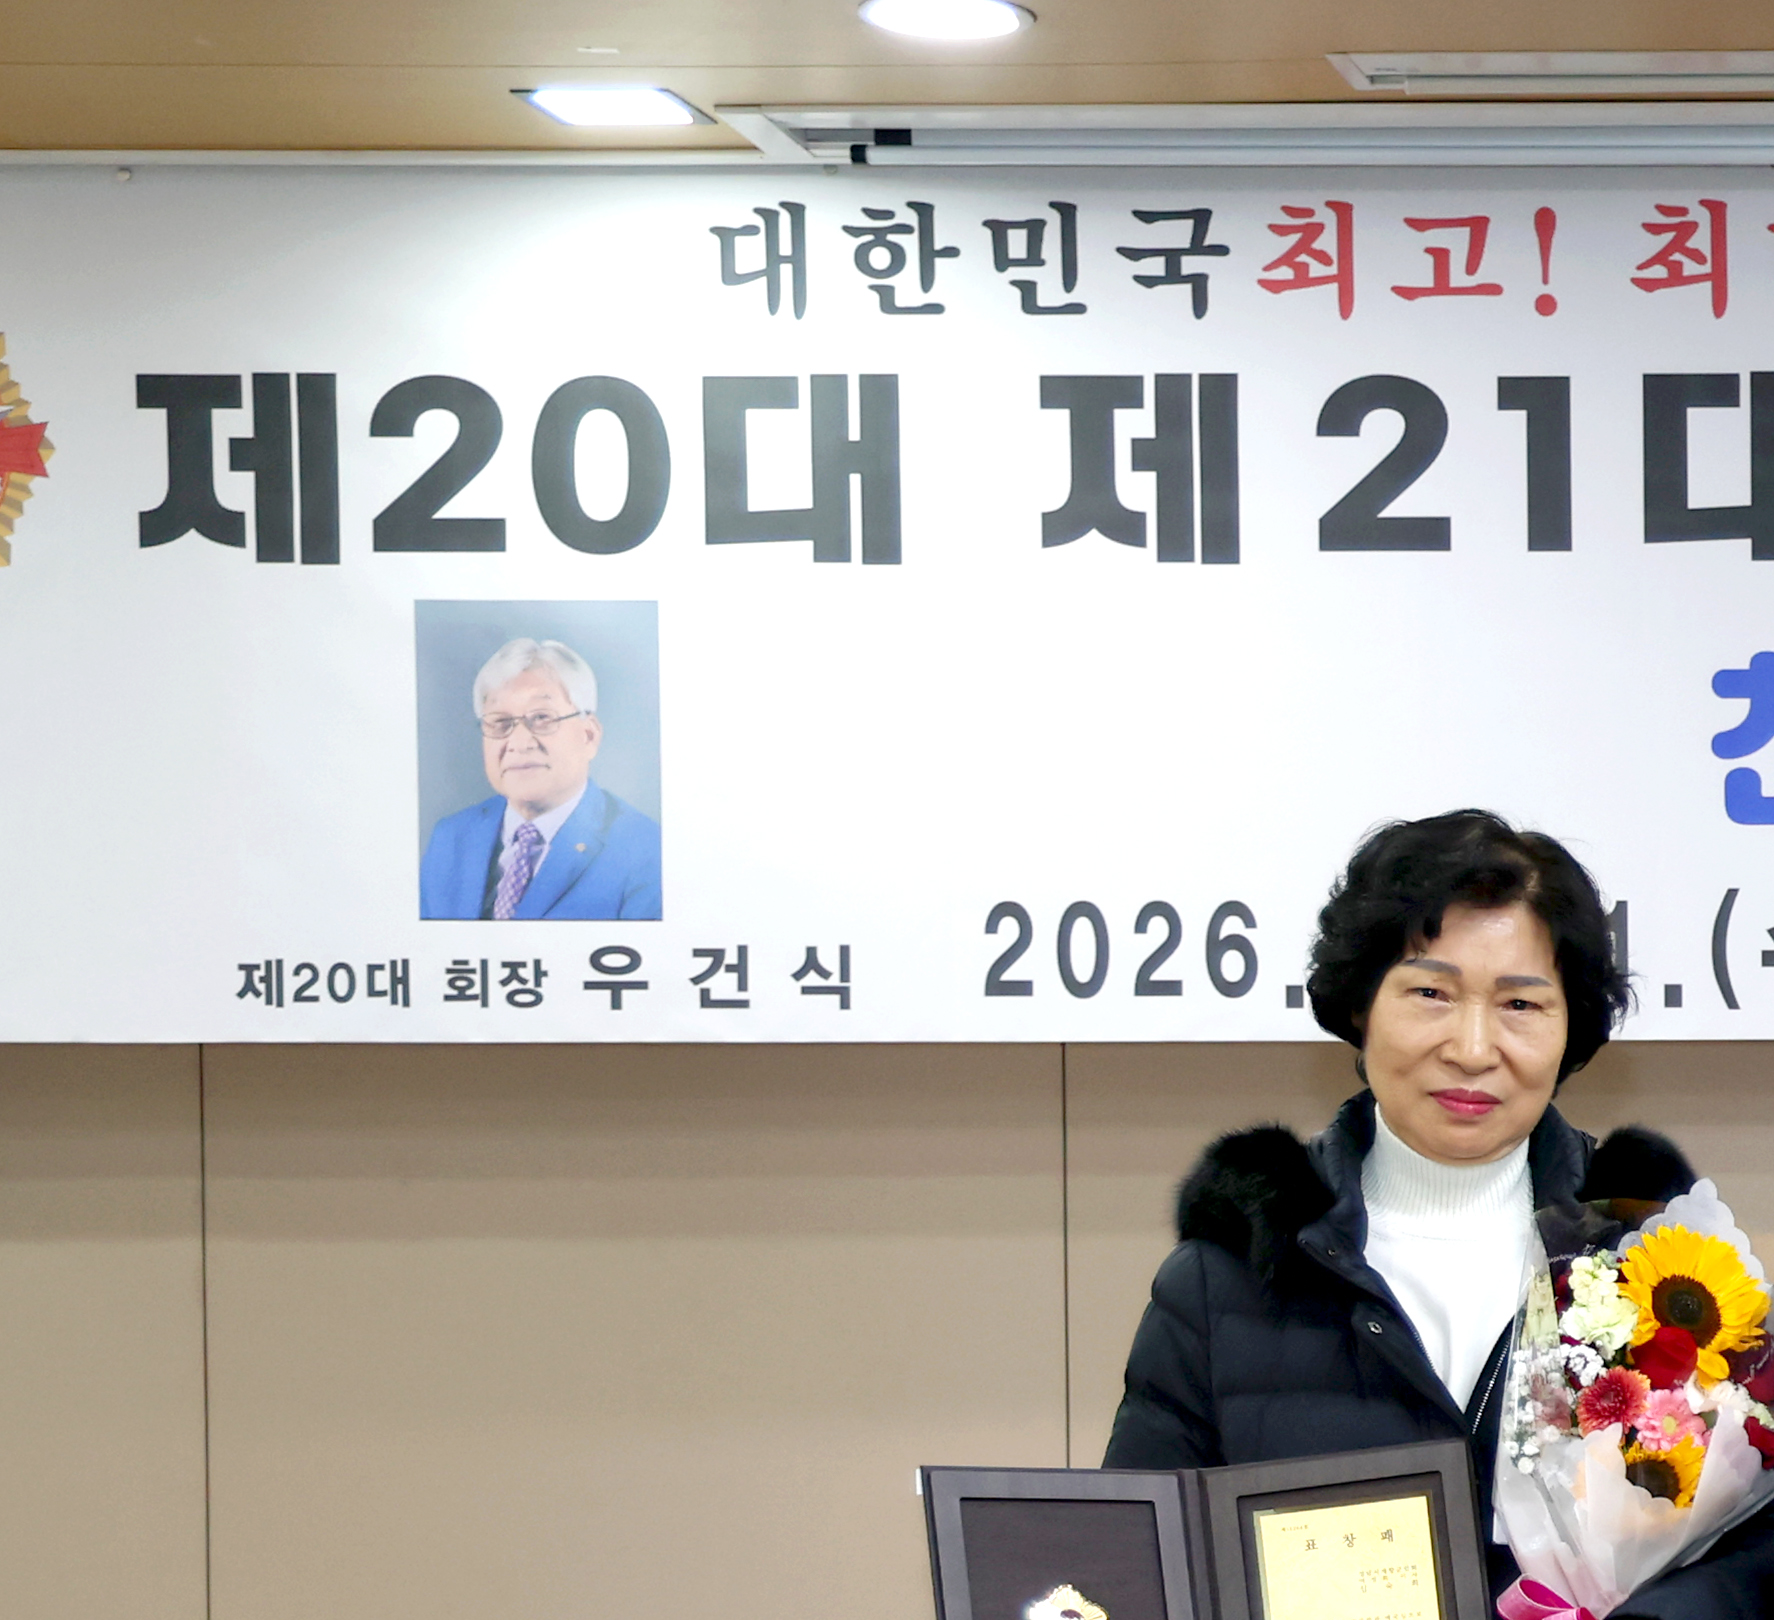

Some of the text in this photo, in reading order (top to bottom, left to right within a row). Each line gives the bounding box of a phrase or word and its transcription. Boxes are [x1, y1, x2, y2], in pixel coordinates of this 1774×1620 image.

[134, 372, 901, 565] 제20대
[236, 959, 410, 1007] 제20대
[443, 959, 548, 1008] 회장
